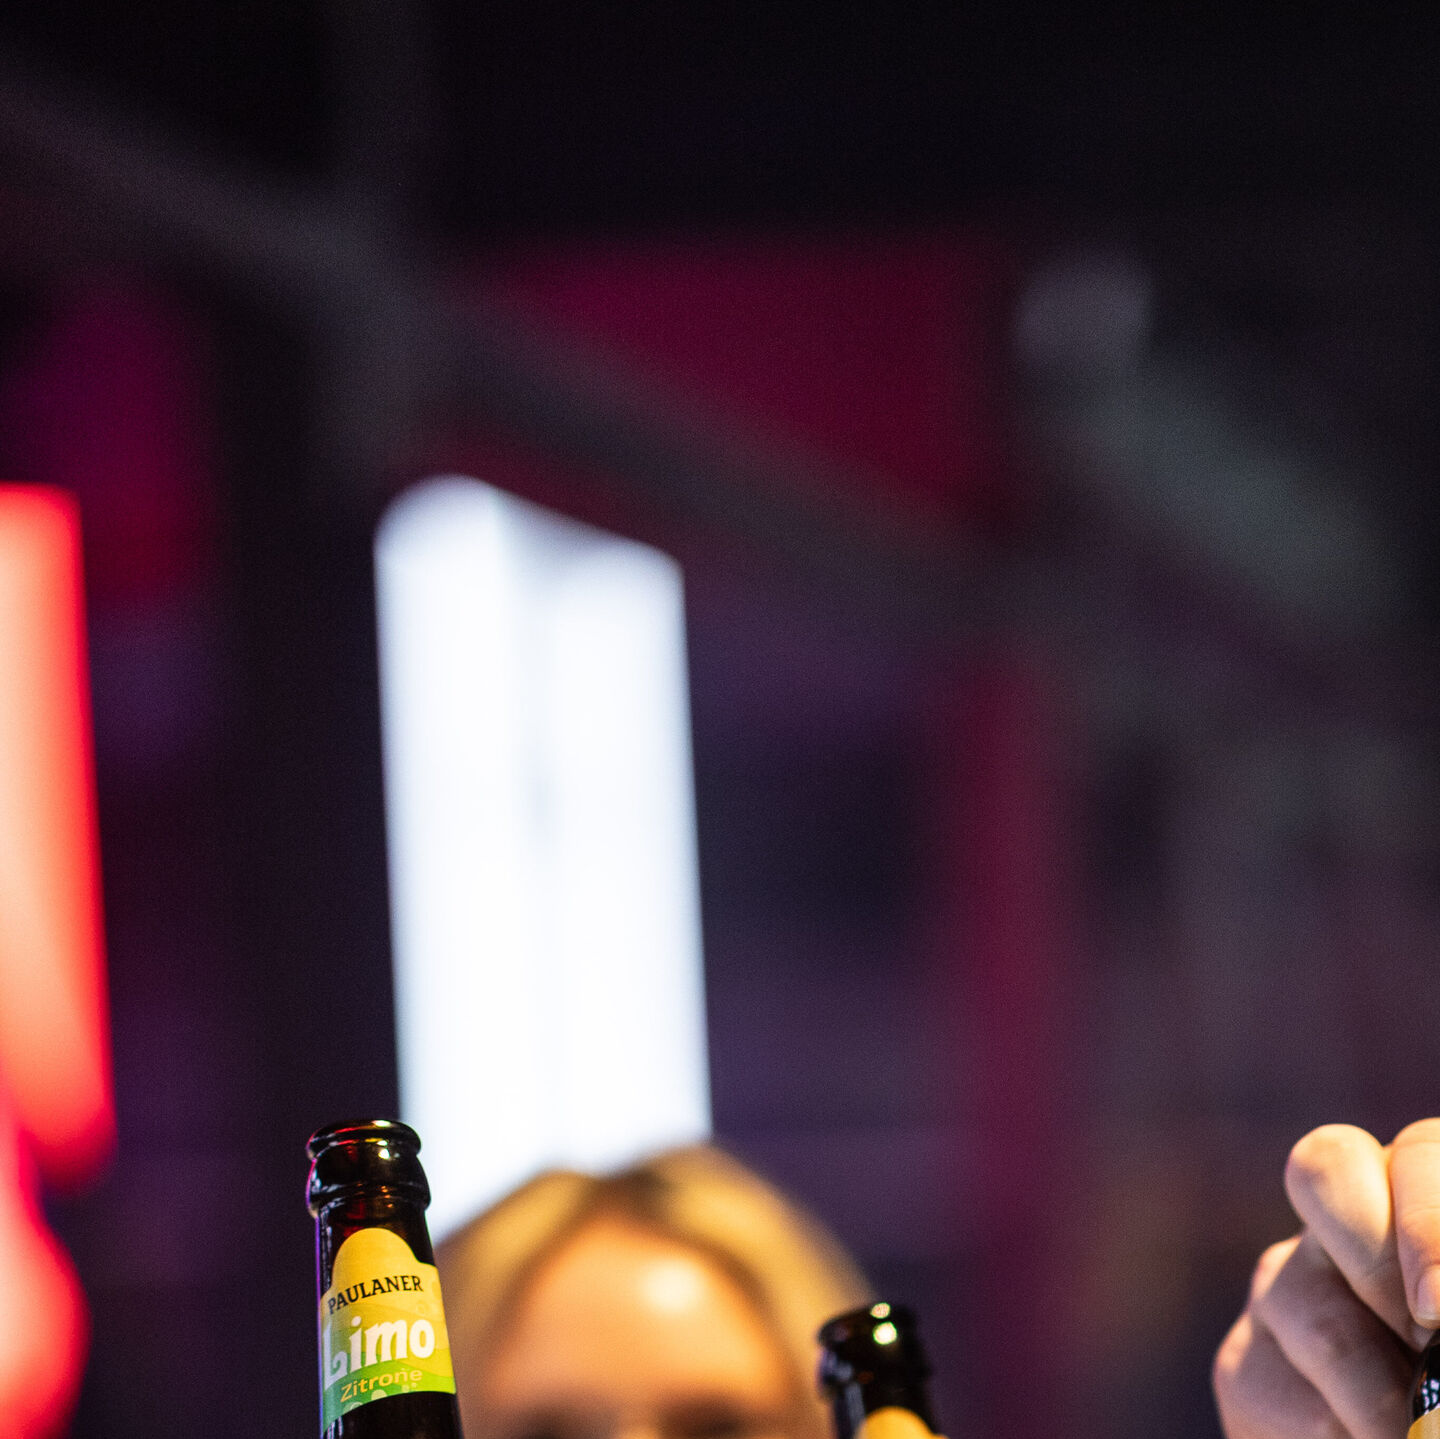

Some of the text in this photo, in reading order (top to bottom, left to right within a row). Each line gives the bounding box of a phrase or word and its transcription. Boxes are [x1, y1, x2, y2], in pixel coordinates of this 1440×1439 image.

[327, 1275, 424, 1315] PAULANER
[323, 1315, 435, 1391] Limo
[340, 1369, 423, 1403] Zitrone
